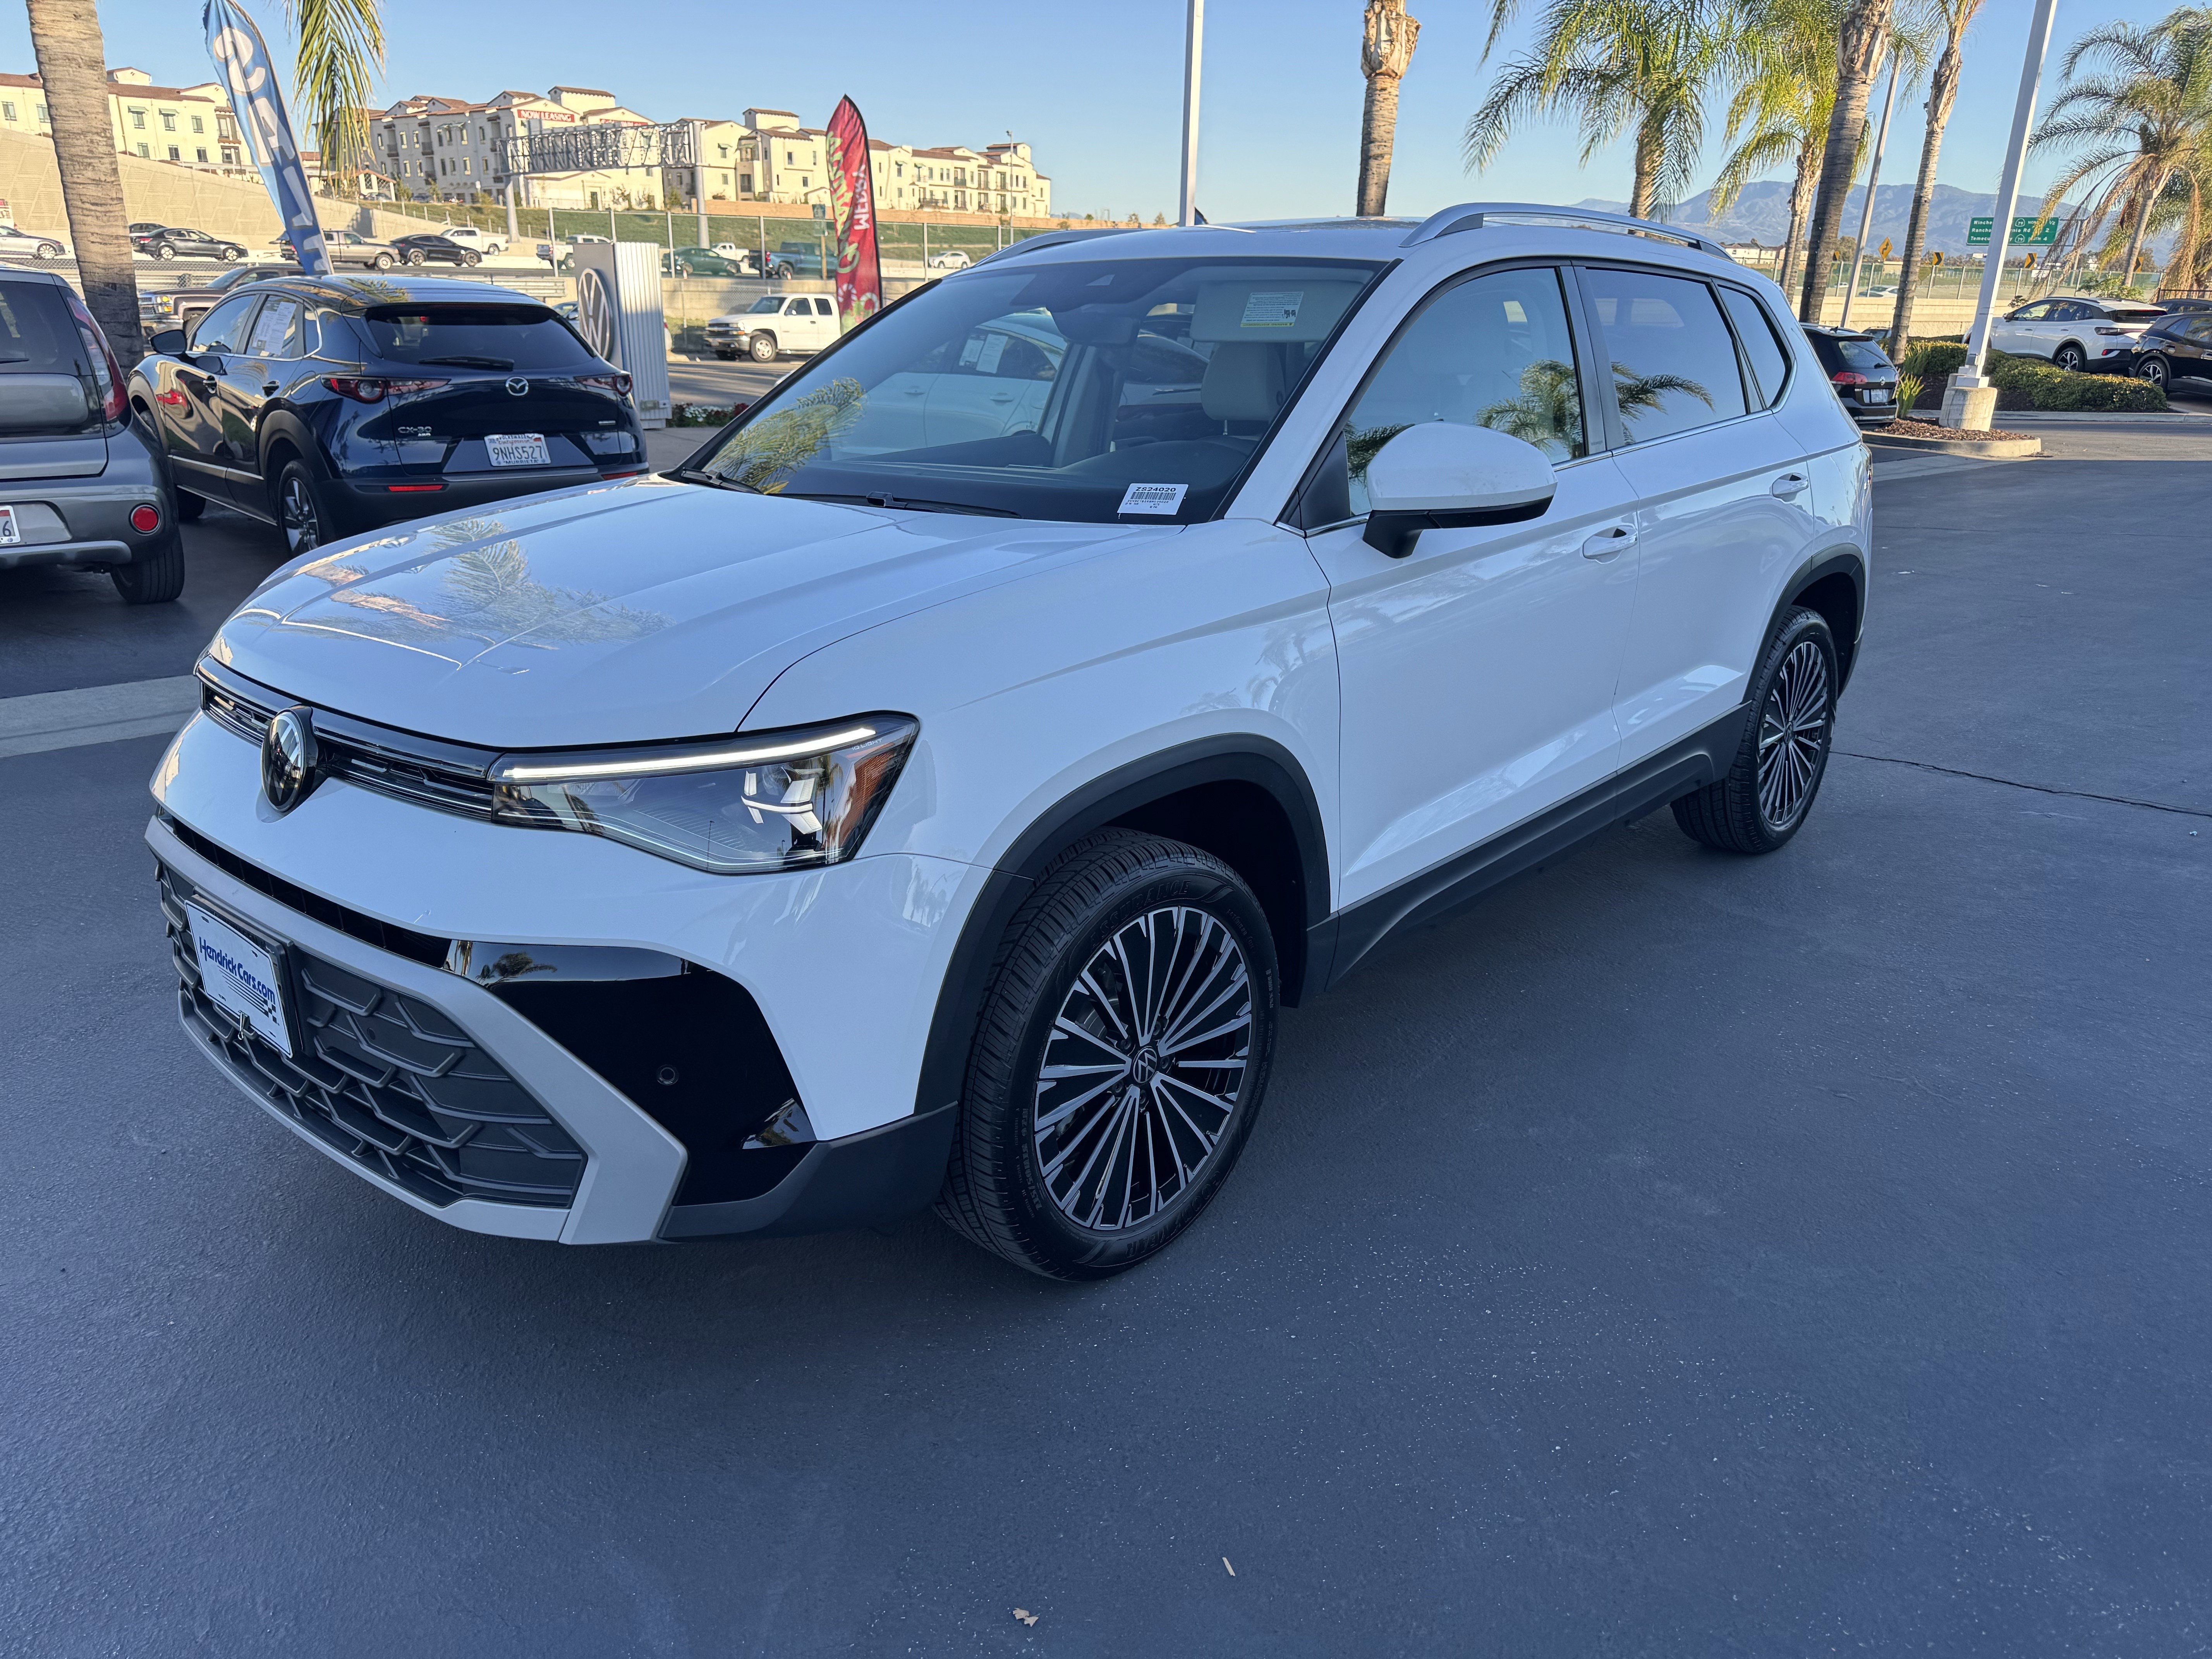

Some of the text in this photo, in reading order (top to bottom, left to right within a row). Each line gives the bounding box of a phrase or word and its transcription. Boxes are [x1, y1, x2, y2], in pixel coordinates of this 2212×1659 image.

[520, 110, 572, 122] NOW LEASING
[493, 446, 542, 460] 9NHS527
[199, 936, 275, 1005] HendrickCars.com
